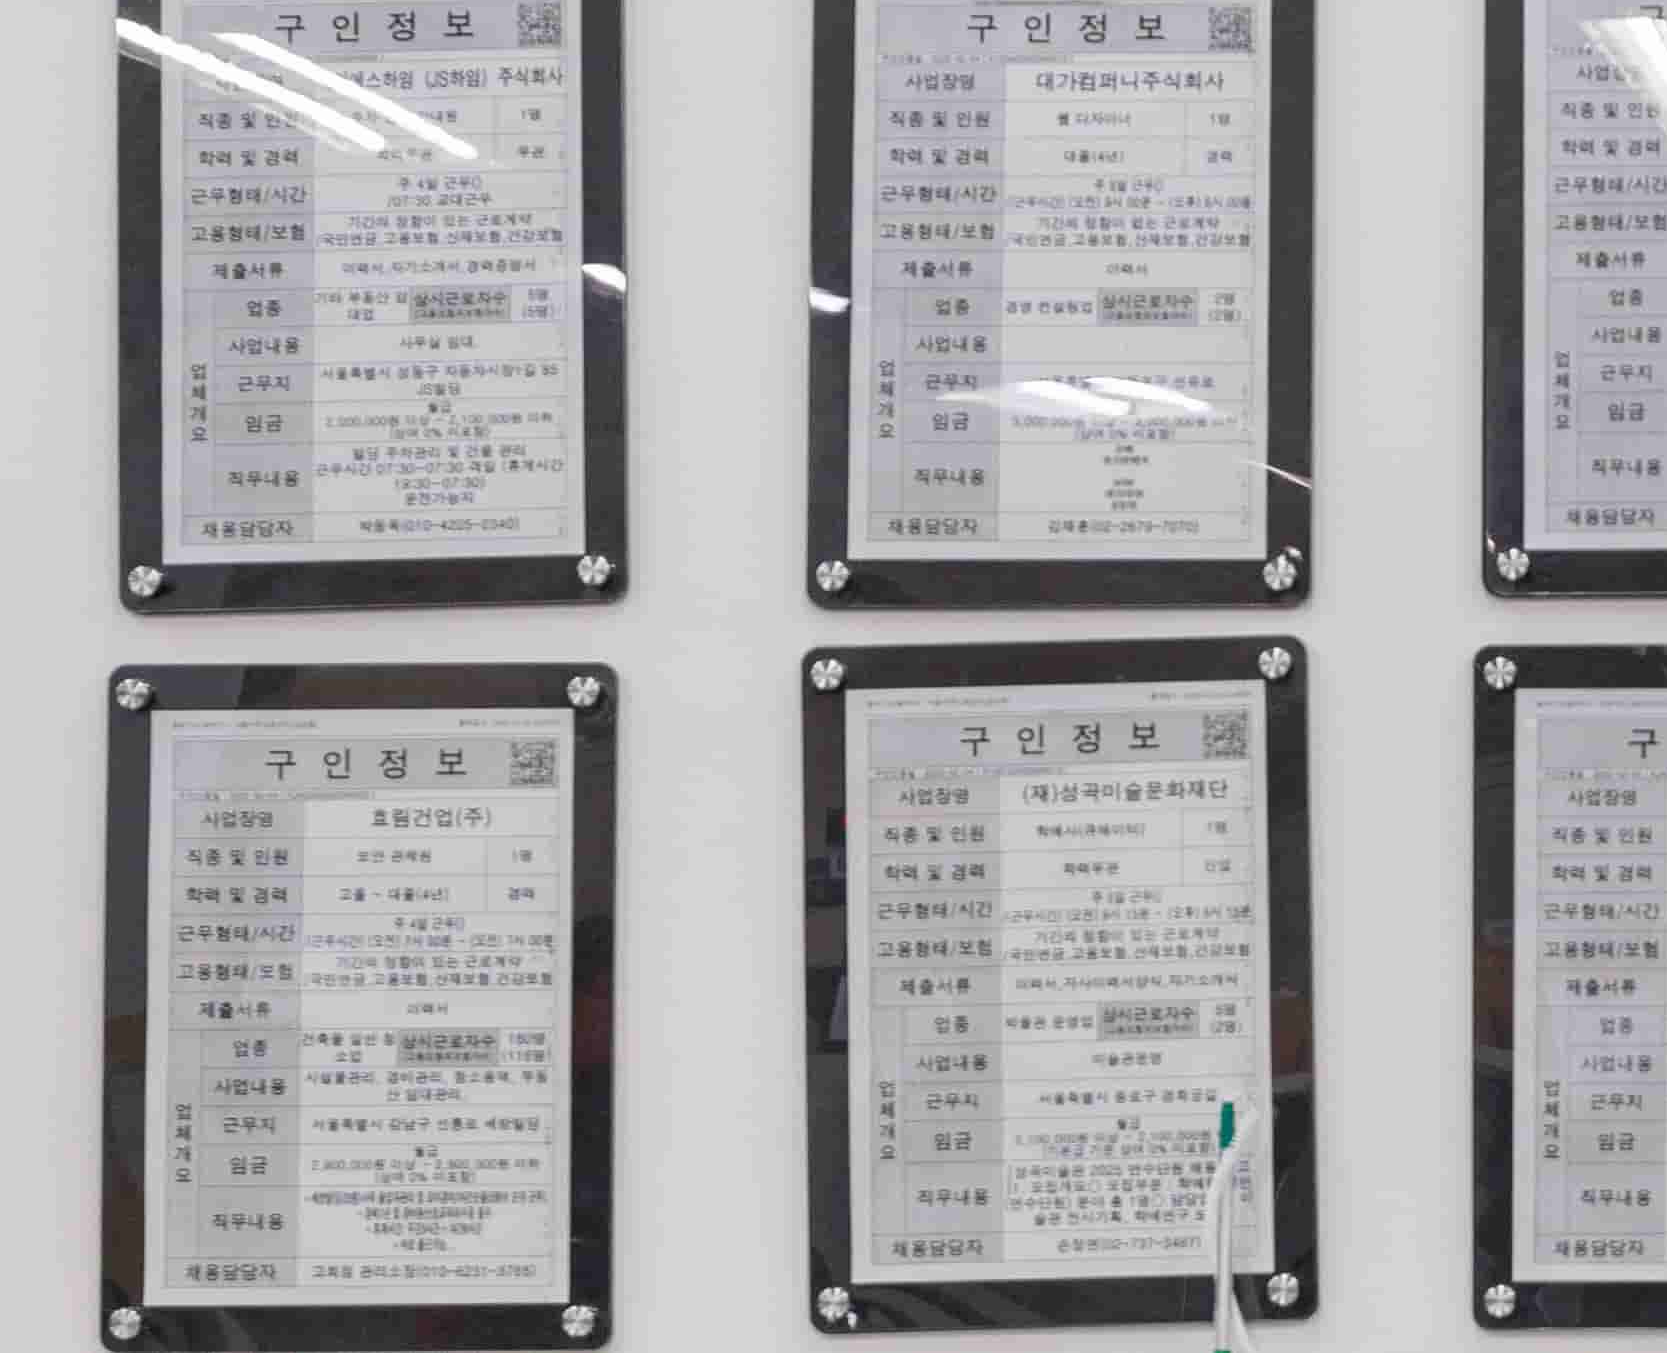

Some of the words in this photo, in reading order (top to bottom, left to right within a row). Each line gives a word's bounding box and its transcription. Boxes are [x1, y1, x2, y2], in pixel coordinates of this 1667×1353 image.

[424, 68, 488, 91] (JS하임)
[497, 66, 564, 88] 주식회사
[904, 70, 976, 92] 사업장명
[1035, 70, 1225, 93] 대가컴퍼니주식회사
[191, 184, 308, 206] 근무형태/시간
[880, 185, 998, 204] 근무형태/시간
[191, 222, 305, 244] 고용형태/보험
[879, 222, 995, 240] 고용형태/보험
[1022, 778, 1229, 804] (재)성곡미술문화재단
